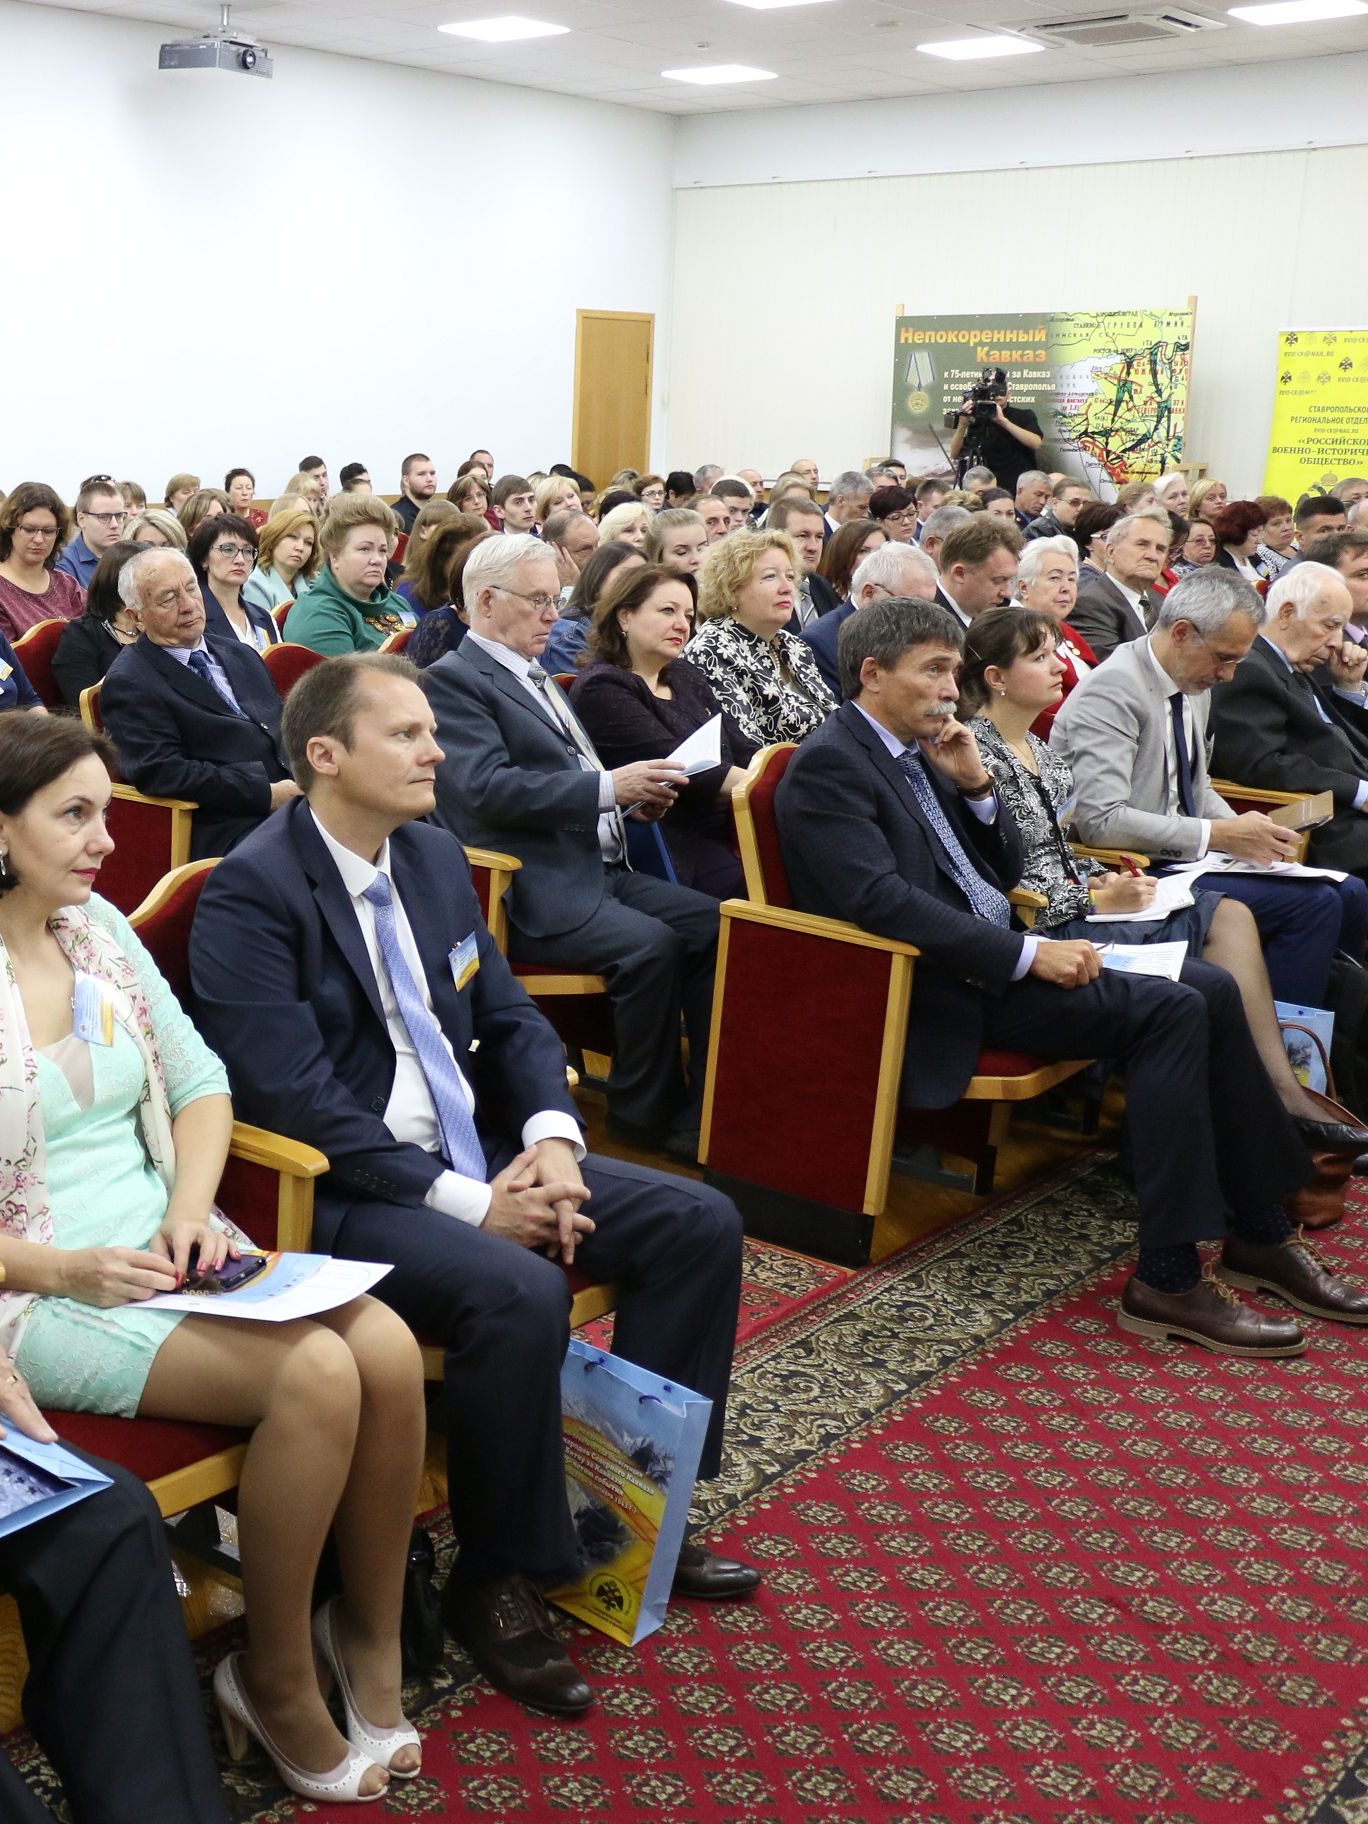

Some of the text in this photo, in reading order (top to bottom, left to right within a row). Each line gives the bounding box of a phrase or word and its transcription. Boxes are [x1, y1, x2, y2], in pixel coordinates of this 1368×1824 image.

[900, 325, 1046, 347] Непокоренный
[977, 346, 1047, 363] Кавказ
[1023, 369, 1050, 378] Кавказ
[1007, 382, 1056, 392] Ставрополья
[1290, 416, 1344, 424] РЕГИОНАЛЬНОЕ
[1298, 436, 1368, 445] «РОССИЙСКО
[1299, 457, 1363, 466] ОБЩЕСТВО»
